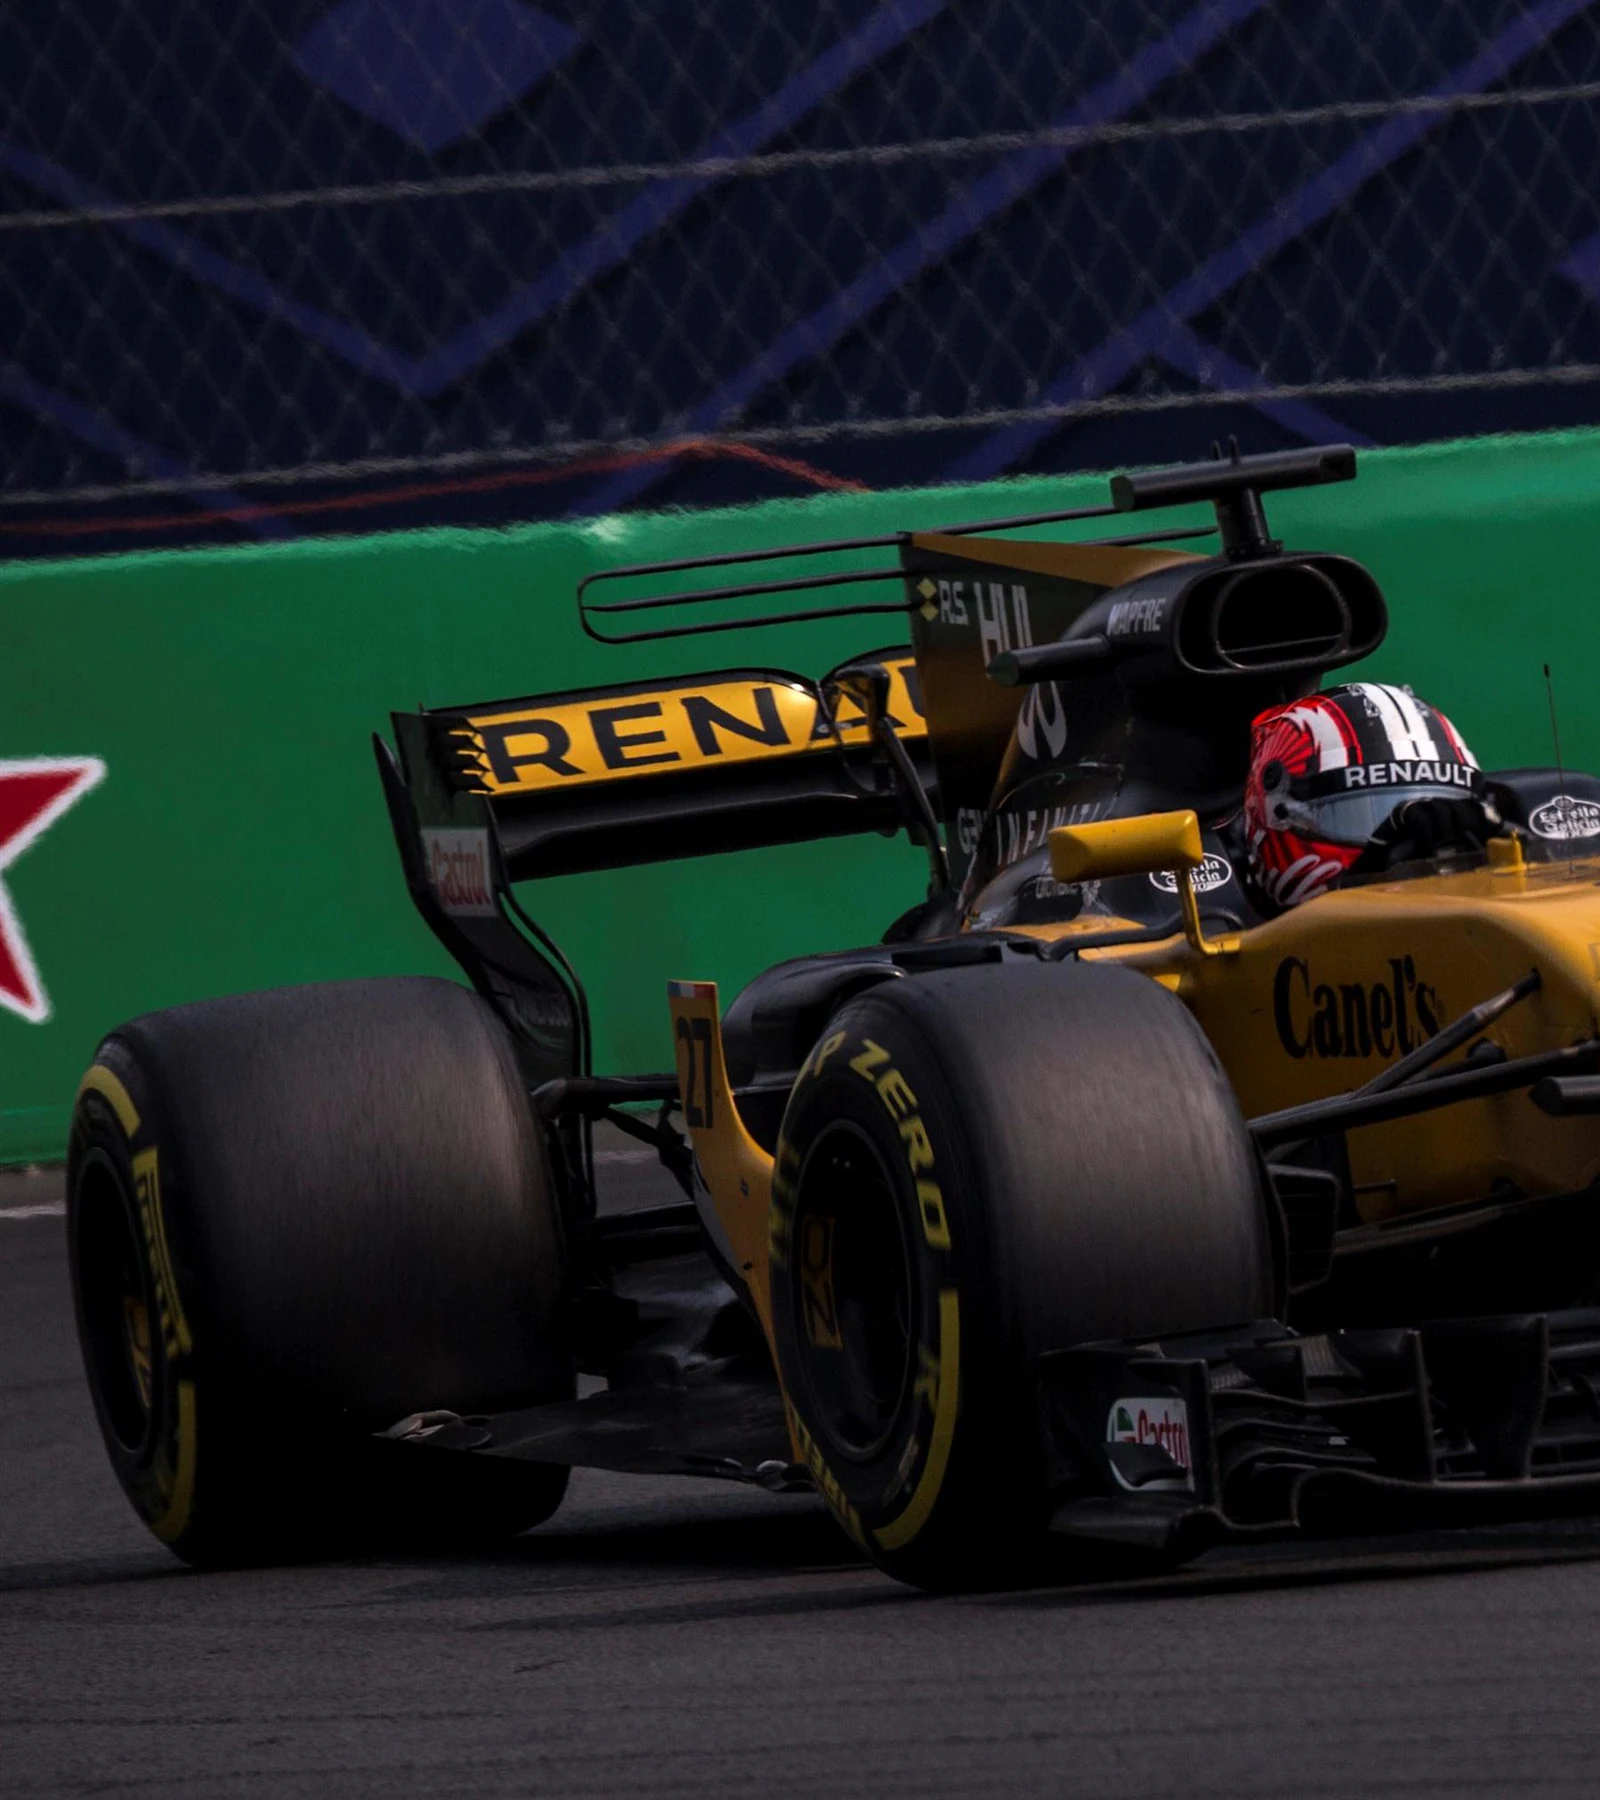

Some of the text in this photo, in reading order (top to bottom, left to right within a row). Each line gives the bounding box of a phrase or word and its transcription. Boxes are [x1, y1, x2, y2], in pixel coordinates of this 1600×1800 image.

[1106, 598, 1166, 636] MAPFRE
[1345, 761, 1475, 788] RENAULT
[1273, 953, 1441, 1059] Canel's
[676, 1017, 713, 1128] 27
[848, 1038, 952, 1250] ZERO
